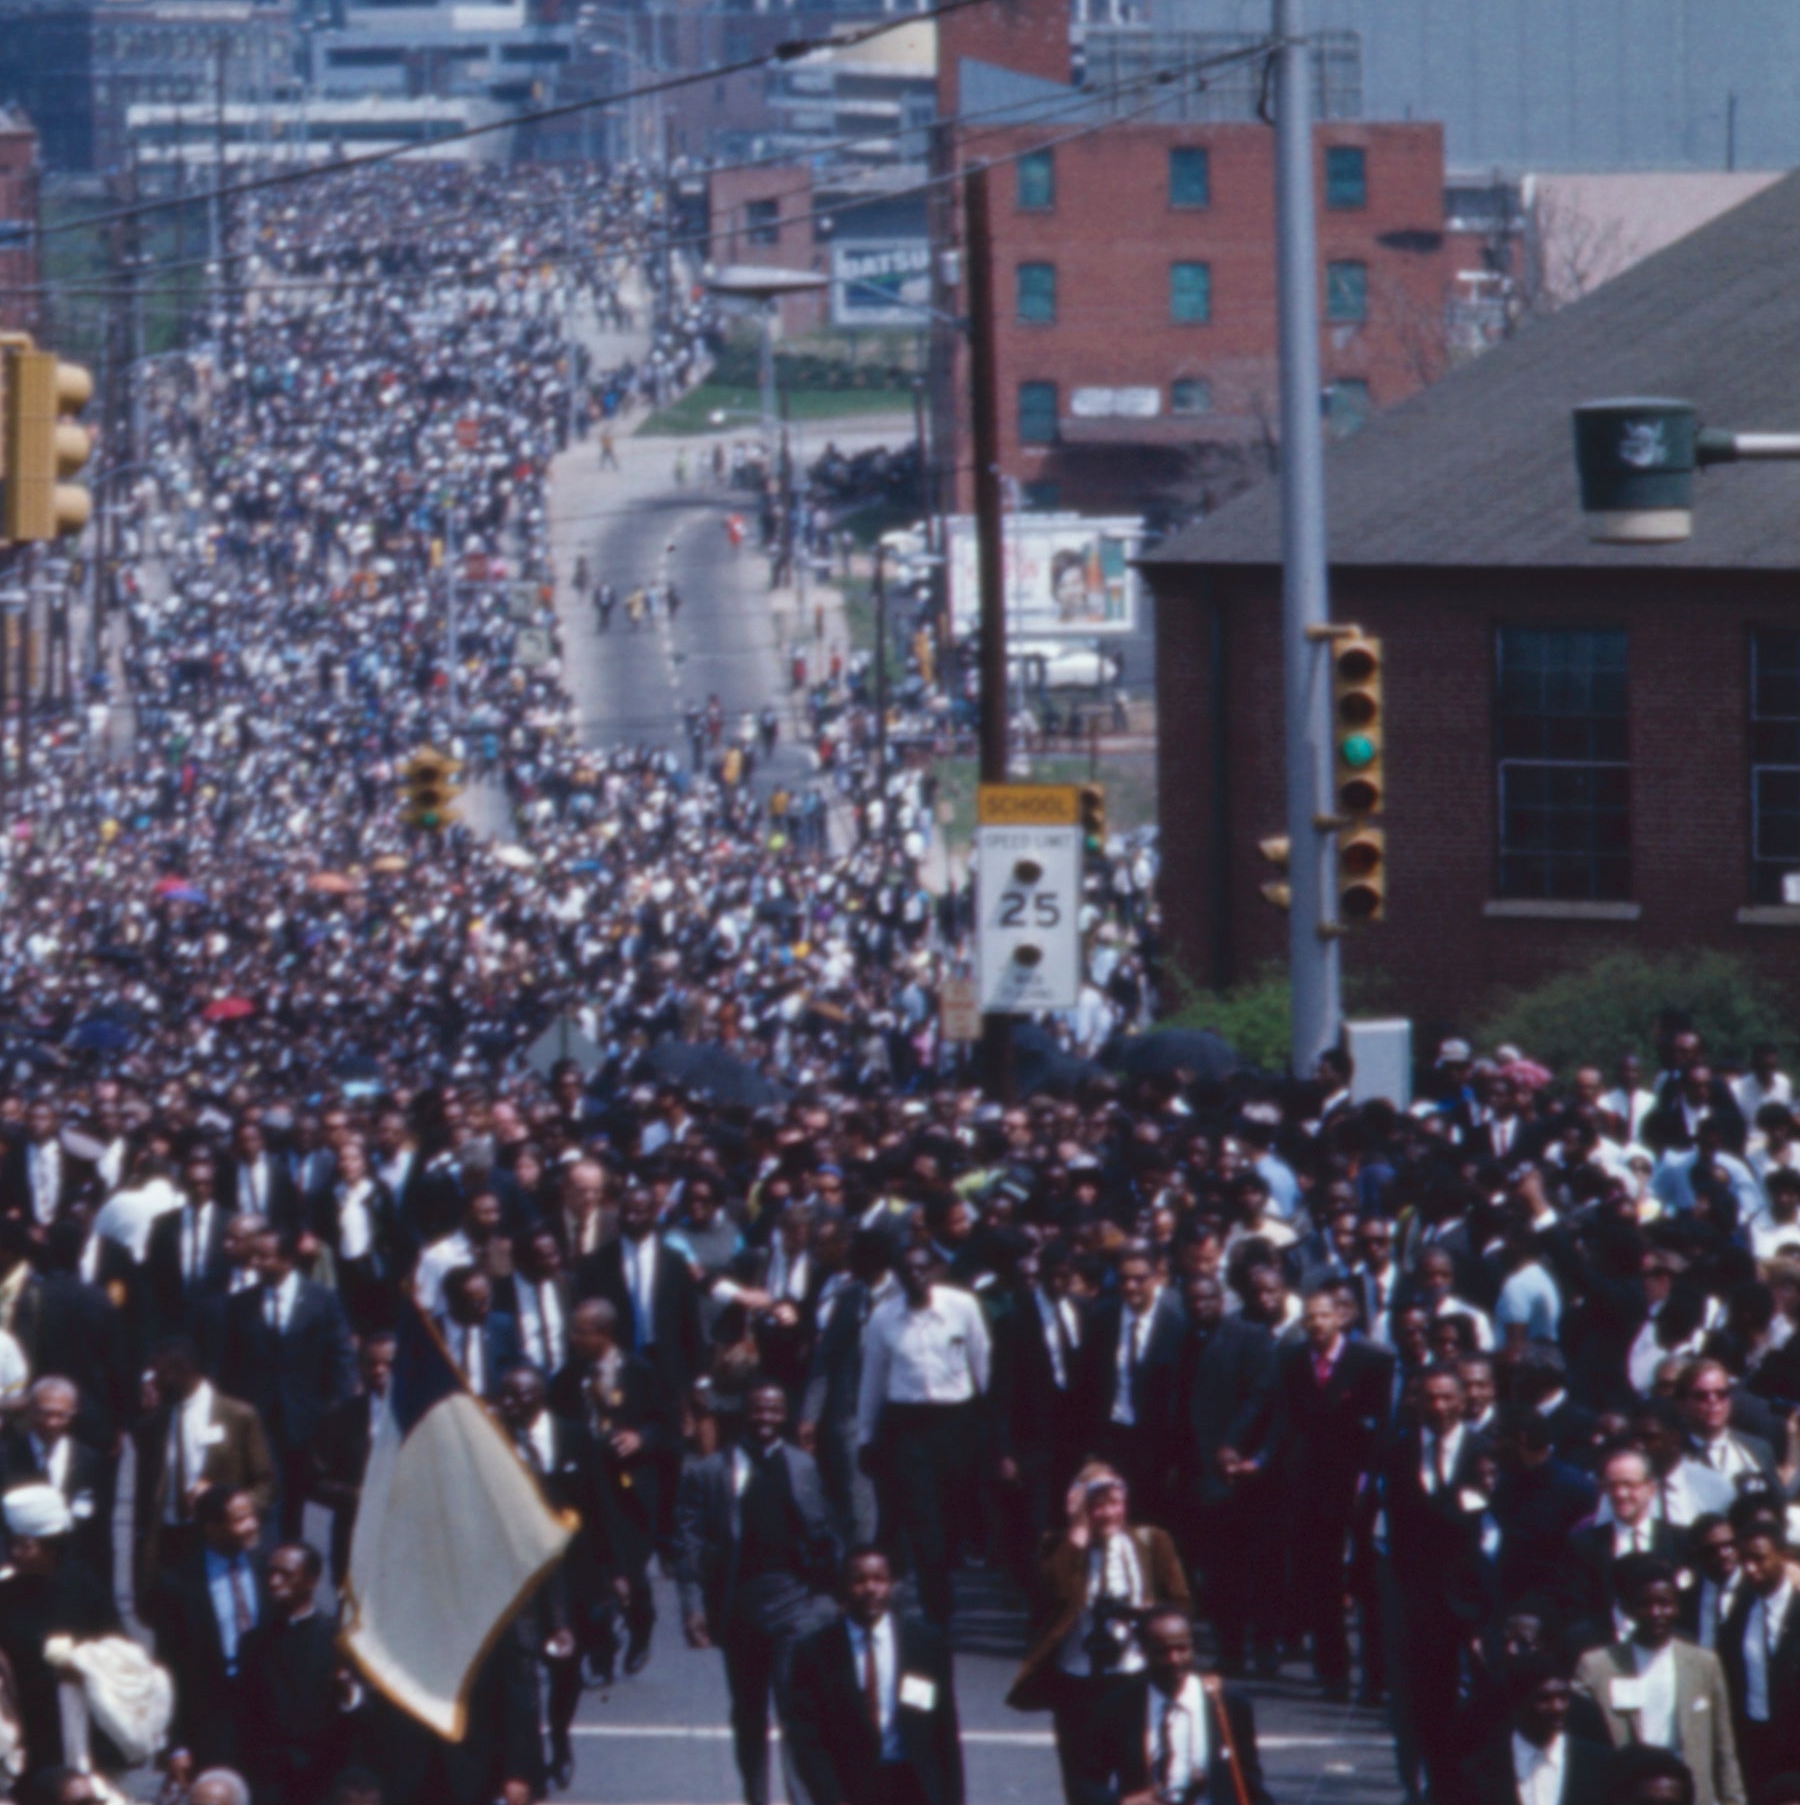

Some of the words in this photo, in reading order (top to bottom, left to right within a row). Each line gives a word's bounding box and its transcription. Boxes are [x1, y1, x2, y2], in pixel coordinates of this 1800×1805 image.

[840, 250, 930, 279] DATSU
[986, 795, 1068, 816] SCHOOL
[984, 832, 1031, 849] SPEED
[1037, 832, 1074, 848] LIMIT
[1000, 892, 1061, 929] 25
